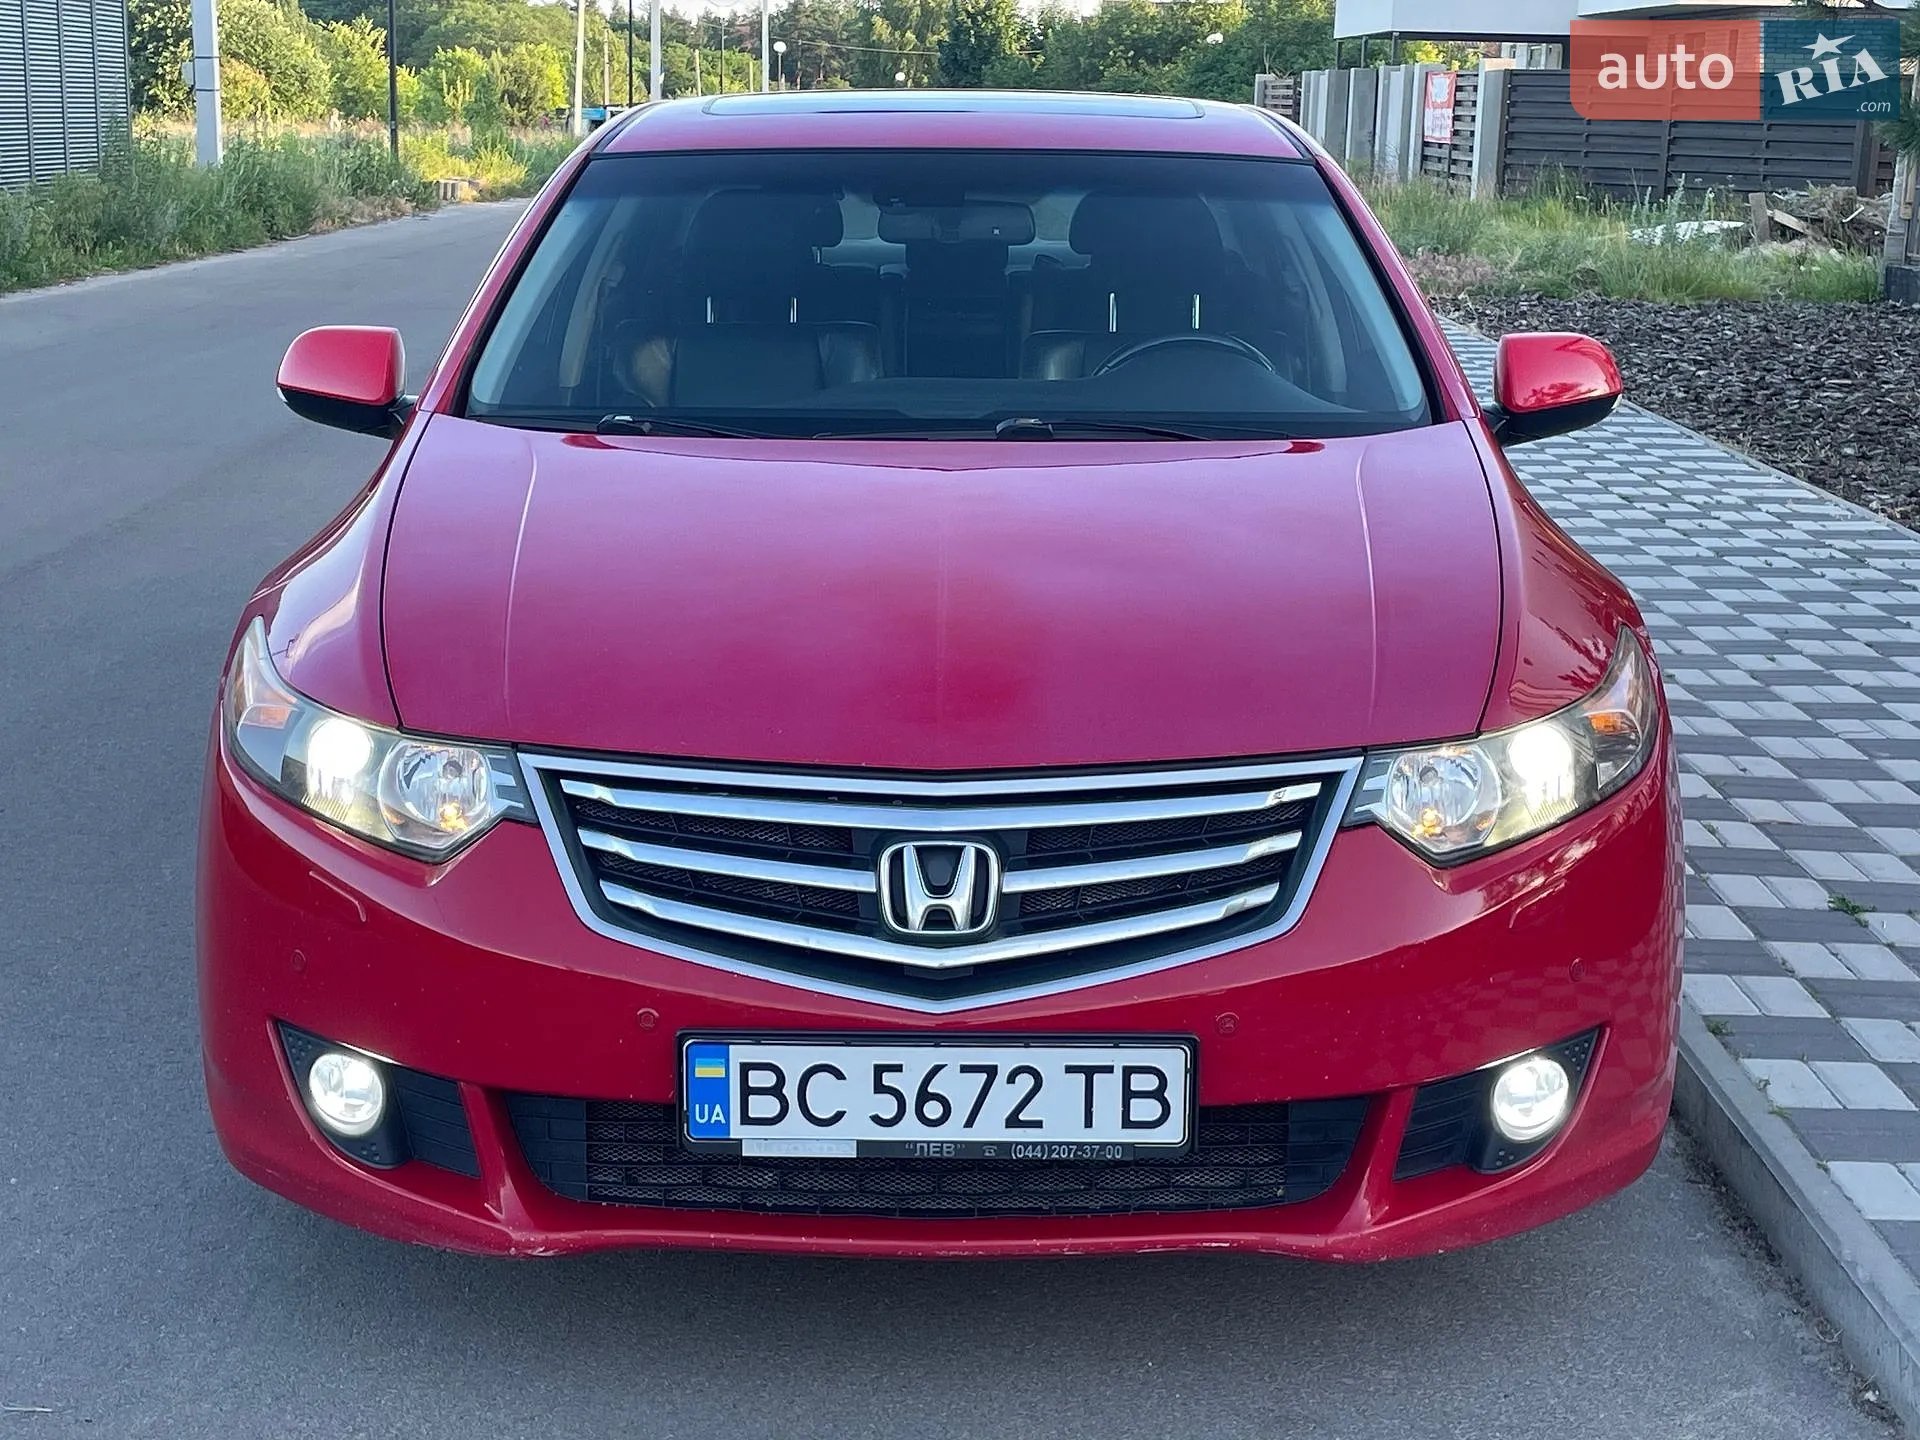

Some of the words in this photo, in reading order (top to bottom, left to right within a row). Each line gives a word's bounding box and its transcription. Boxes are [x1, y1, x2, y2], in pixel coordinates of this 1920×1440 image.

[694, 1104, 726, 1124] UA
[739, 1061, 847, 1127] BC
[869, 1063, 1044, 1129] 5672
[1064, 1064, 1172, 1130] TB
